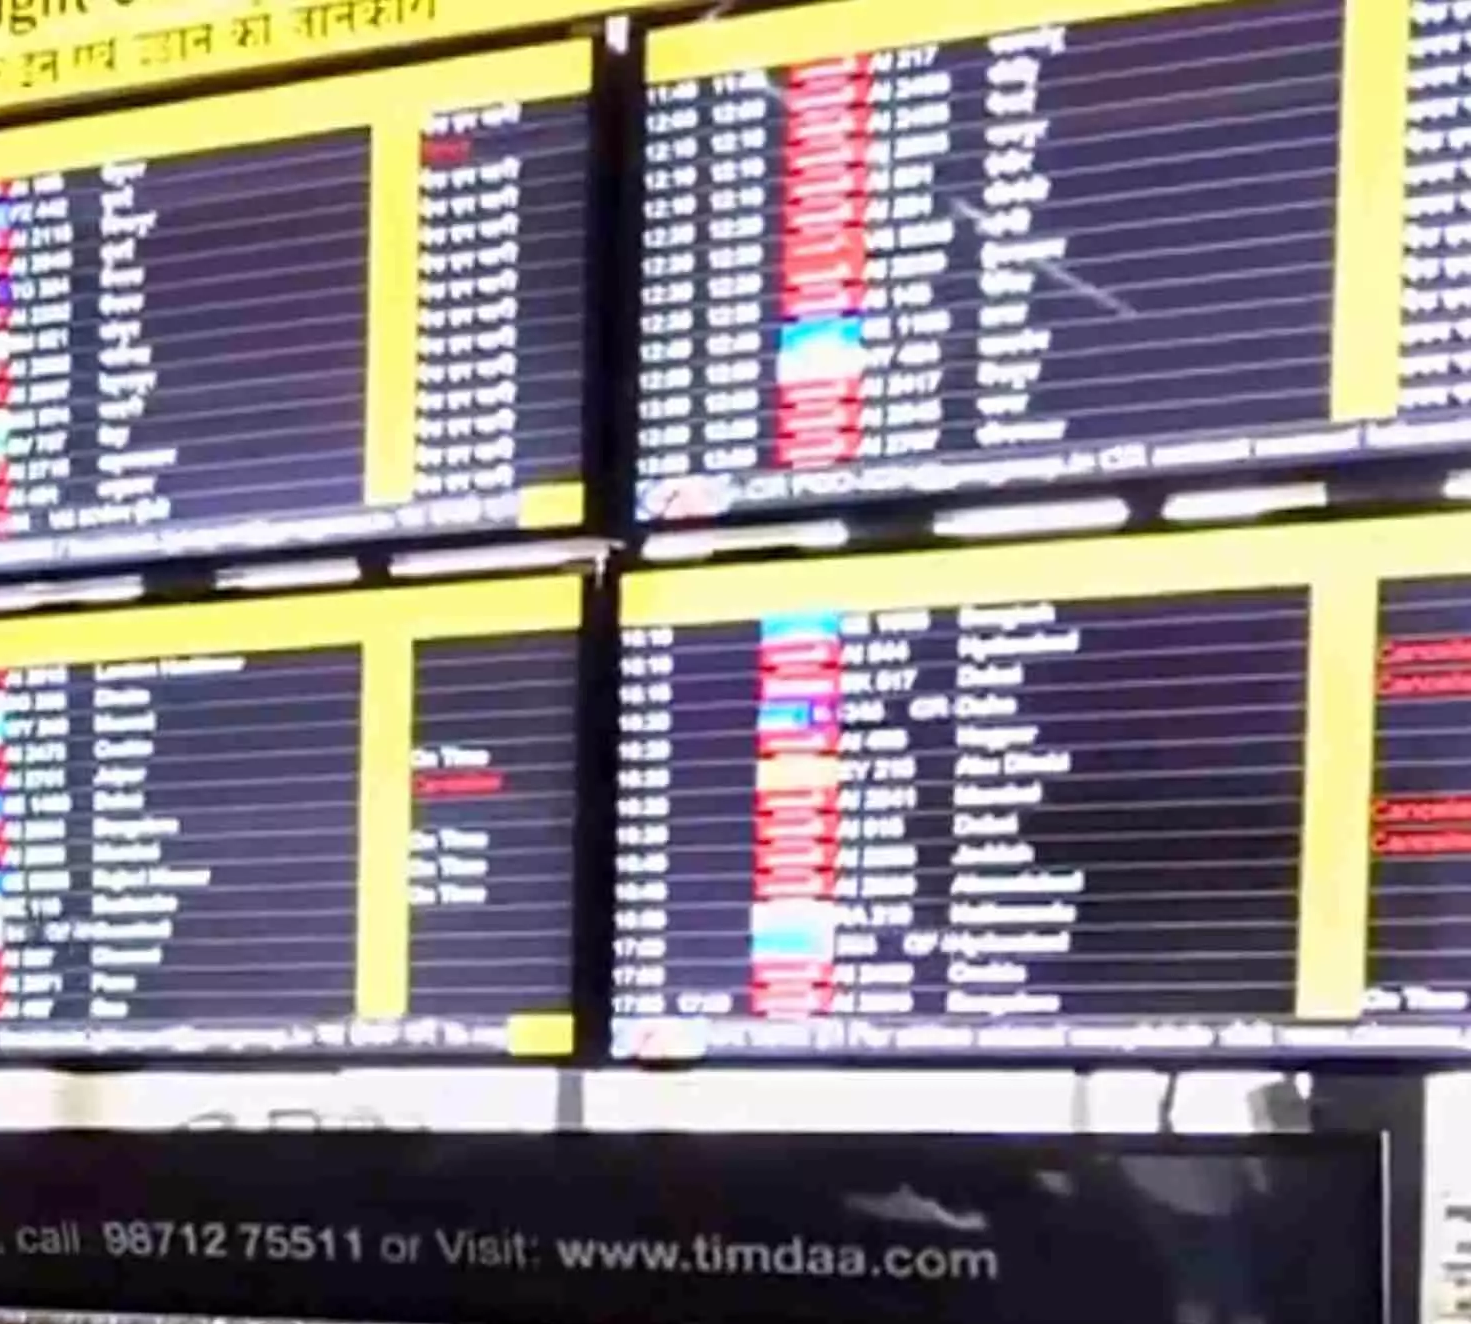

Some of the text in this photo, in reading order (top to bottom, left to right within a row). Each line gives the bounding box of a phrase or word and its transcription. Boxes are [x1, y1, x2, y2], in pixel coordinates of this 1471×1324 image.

[16, 1220, 82, 1256] call
[103, 1220, 229, 1259] 98712
[240, 1222, 364, 1263] 75511
[380, 1232, 422, 1266] or
[434, 1226, 542, 1269] Visit:
[557, 1232, 1000, 1280] www.timdaa.com
